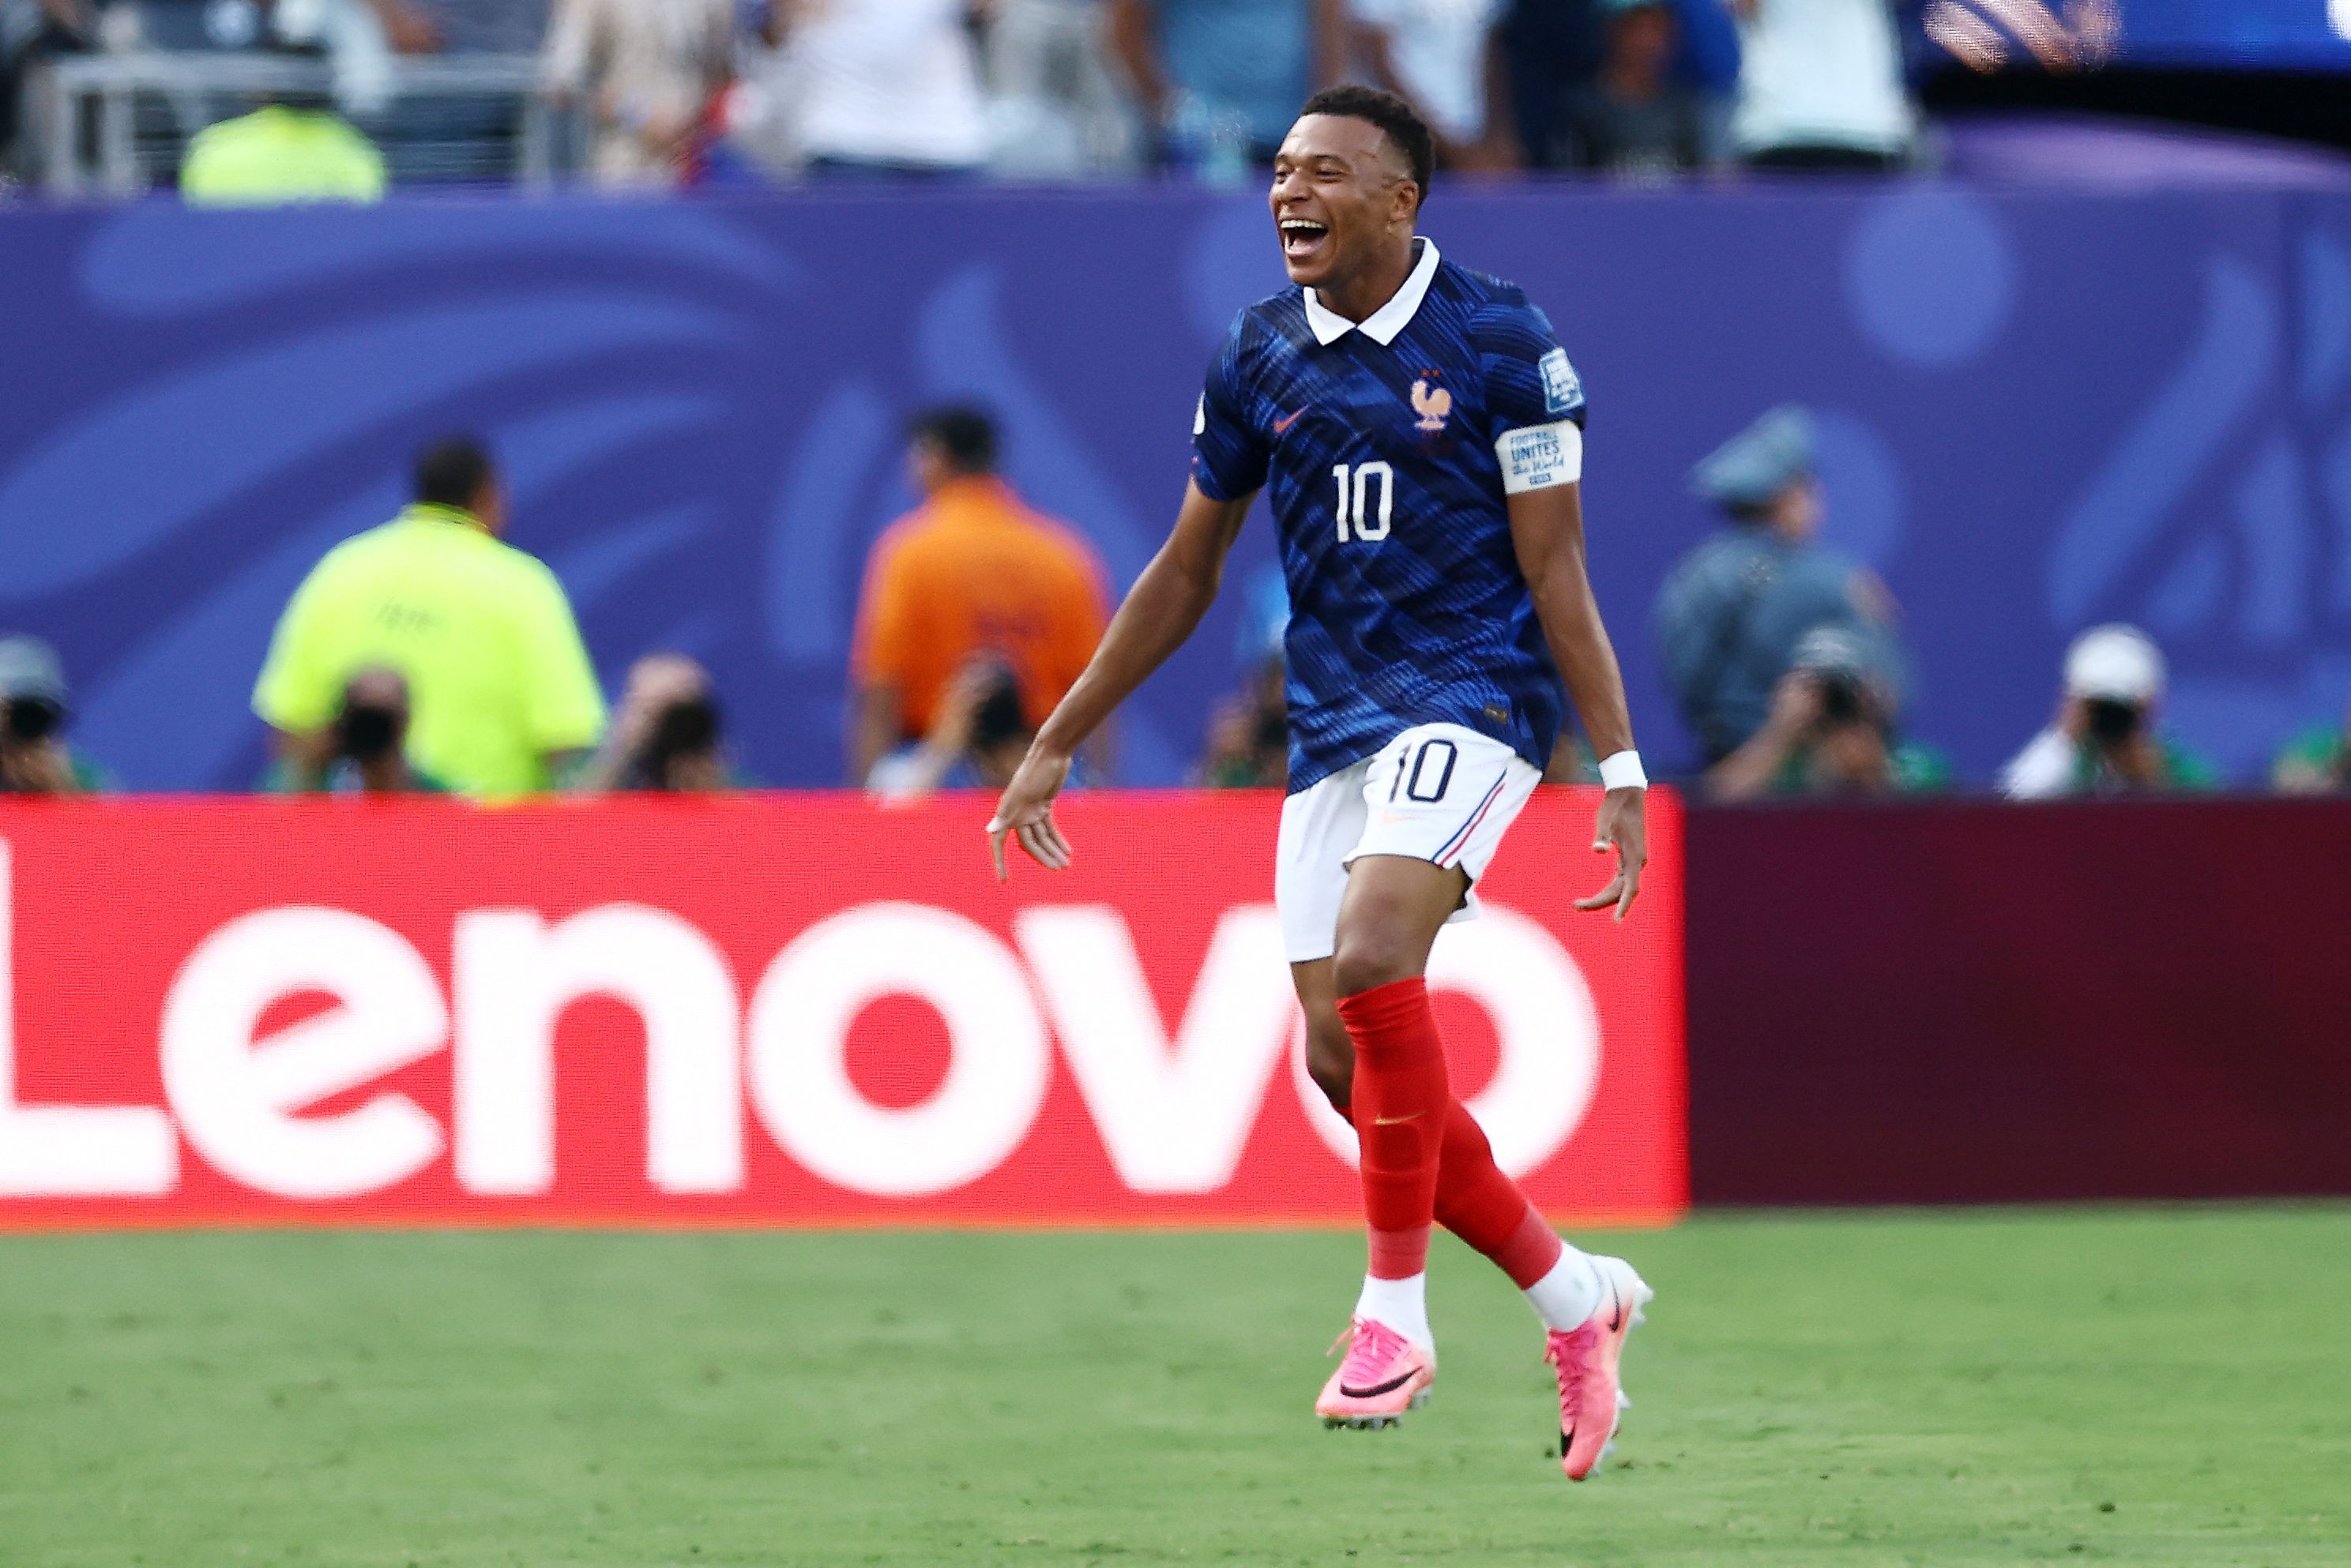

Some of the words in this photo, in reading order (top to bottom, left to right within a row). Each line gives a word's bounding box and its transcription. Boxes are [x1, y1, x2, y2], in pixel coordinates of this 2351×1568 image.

[1512, 440, 1559, 462] UNITES
[1333, 461, 1394, 543] 10
[1388, 739, 1458, 803] 10
